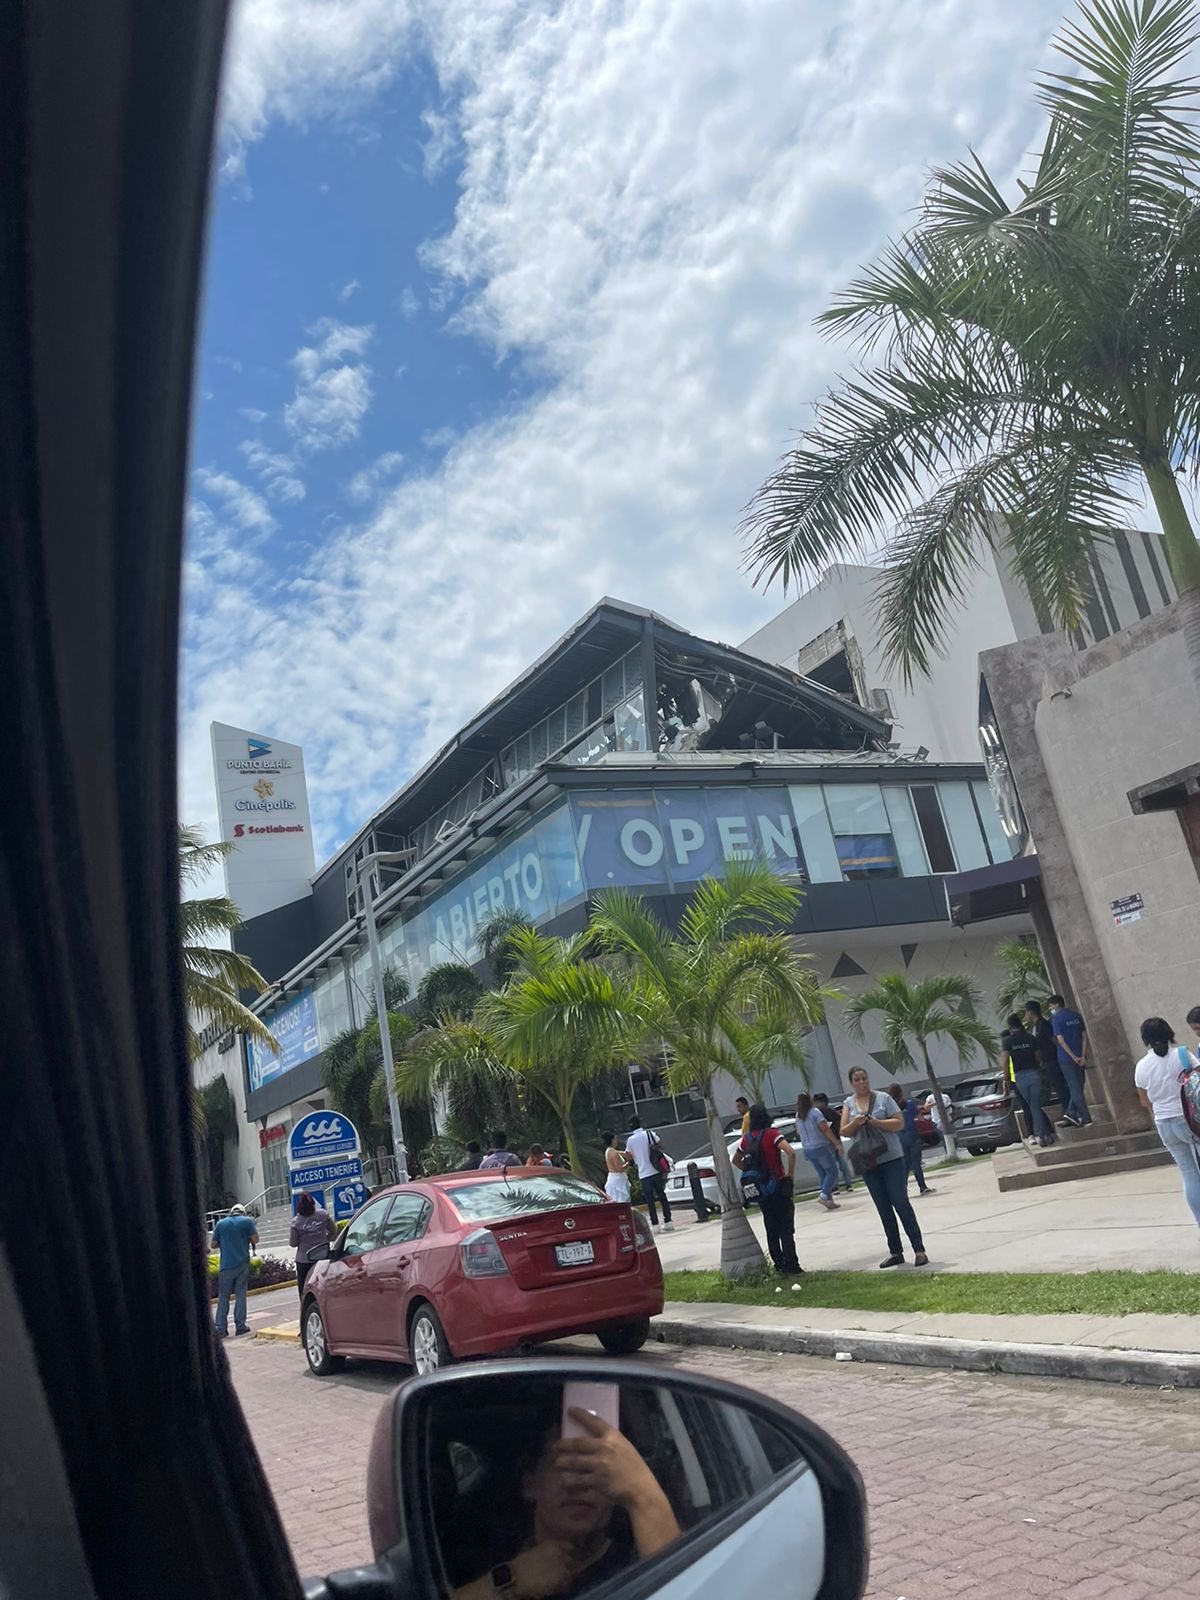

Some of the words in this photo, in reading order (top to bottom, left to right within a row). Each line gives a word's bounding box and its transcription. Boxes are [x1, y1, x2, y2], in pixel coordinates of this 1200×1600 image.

[228, 760, 262, 769] PUNTO
[235, 799, 295, 812] Cinépolis
[248, 824, 304, 834] Scotiabank
[434, 852, 543, 943] ABIERTO
[620, 814, 798, 867] OPEN
[294, 1169, 323, 1184] ACCESO
[324, 1163, 358, 1177] TENERIFE
